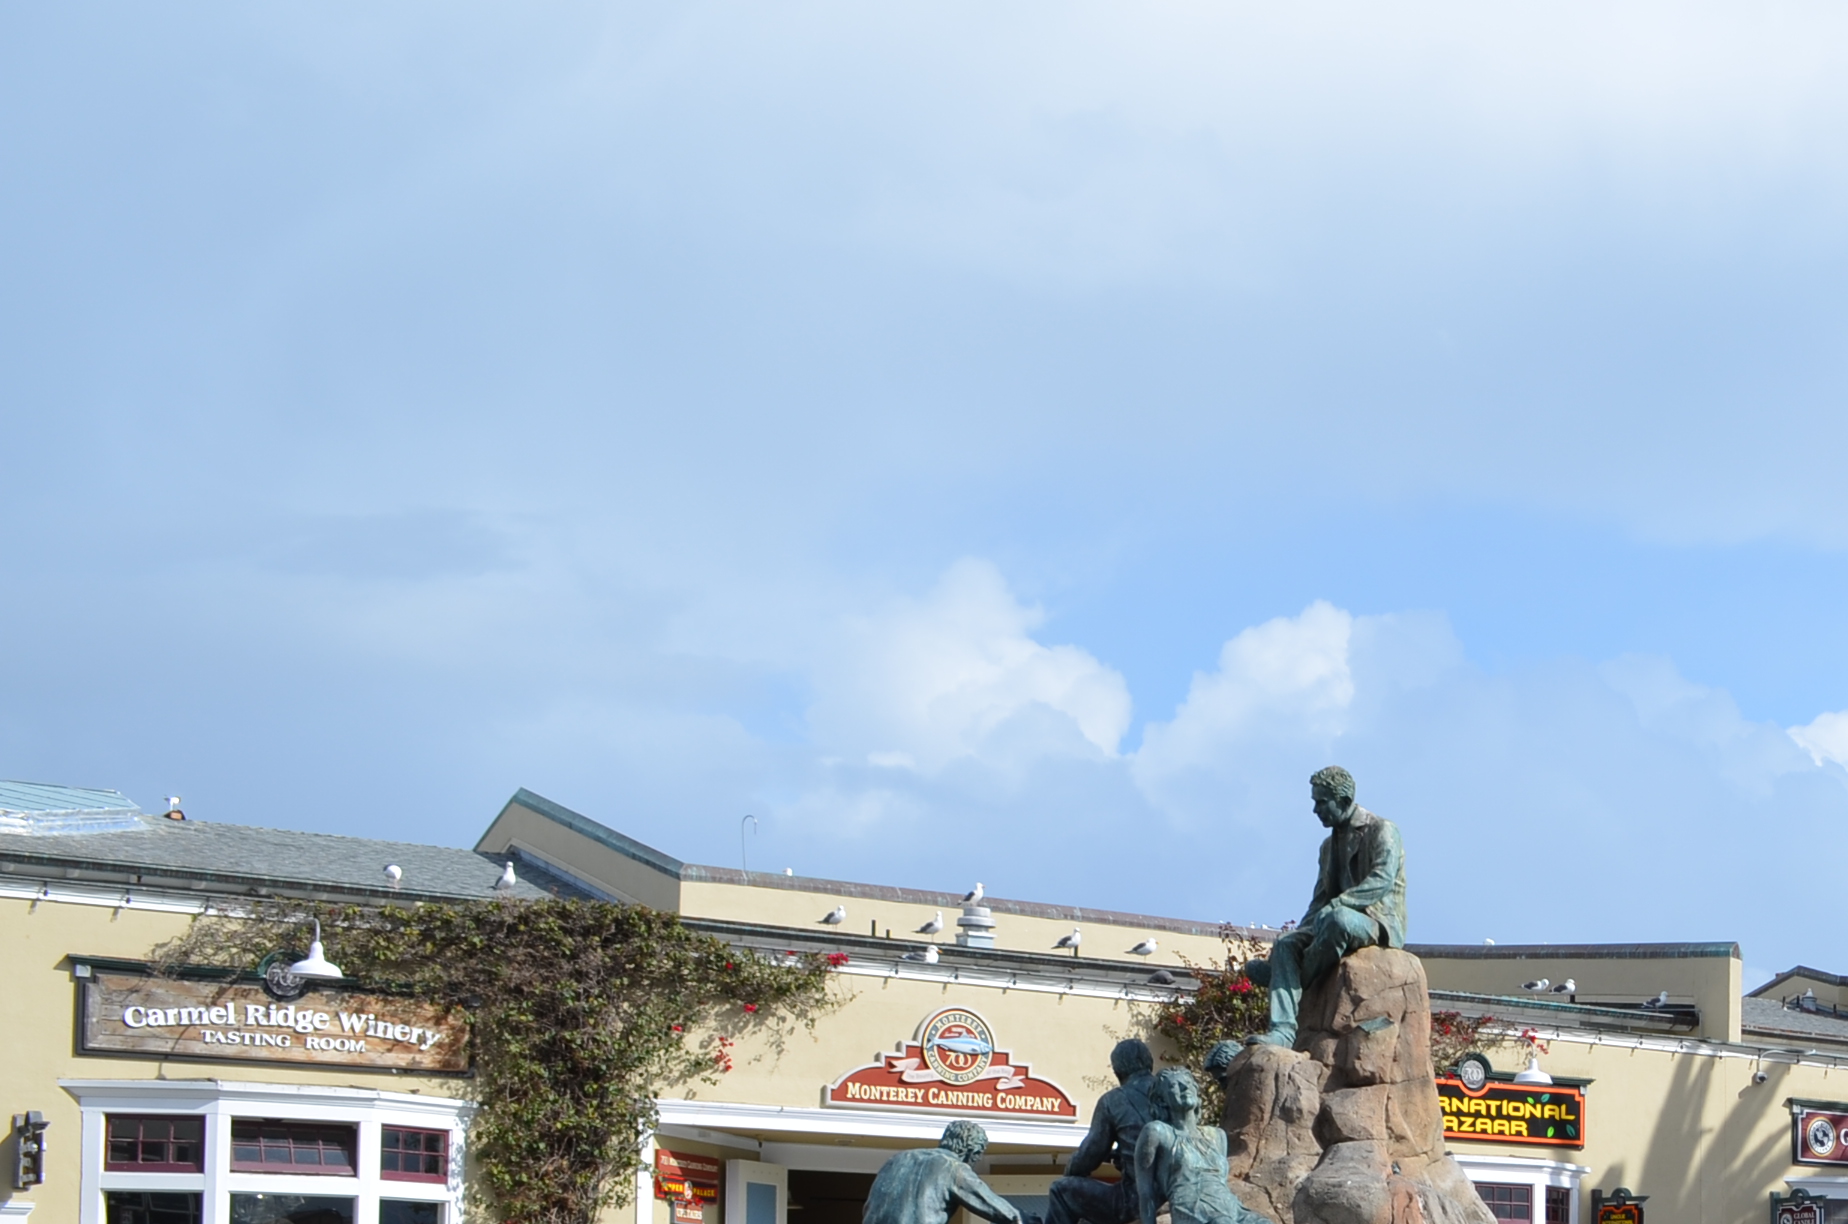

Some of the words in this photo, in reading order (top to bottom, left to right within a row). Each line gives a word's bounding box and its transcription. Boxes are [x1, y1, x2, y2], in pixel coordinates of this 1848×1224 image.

[123, 1003, 236, 1029] Carmel
[245, 1005, 330, 1033] Ridge
[338, 1011, 442, 1050] Winery
[935, 1014, 983, 1032] MONTEREY
[201, 1030, 291, 1048] TASTING
[306, 1036, 366, 1053] ROOM
[927, 1051, 956, 1081] CANNING
[957, 1056, 988, 1082] COMPANY
[945, 1051, 972, 1068] 700
[846, 1081, 925, 1103] MONTEREY
[928, 1087, 993, 1107] CANNING
[996, 1092, 1062, 1112] COMPANY
[1793, 1211, 1815, 1219] GLOBAL
